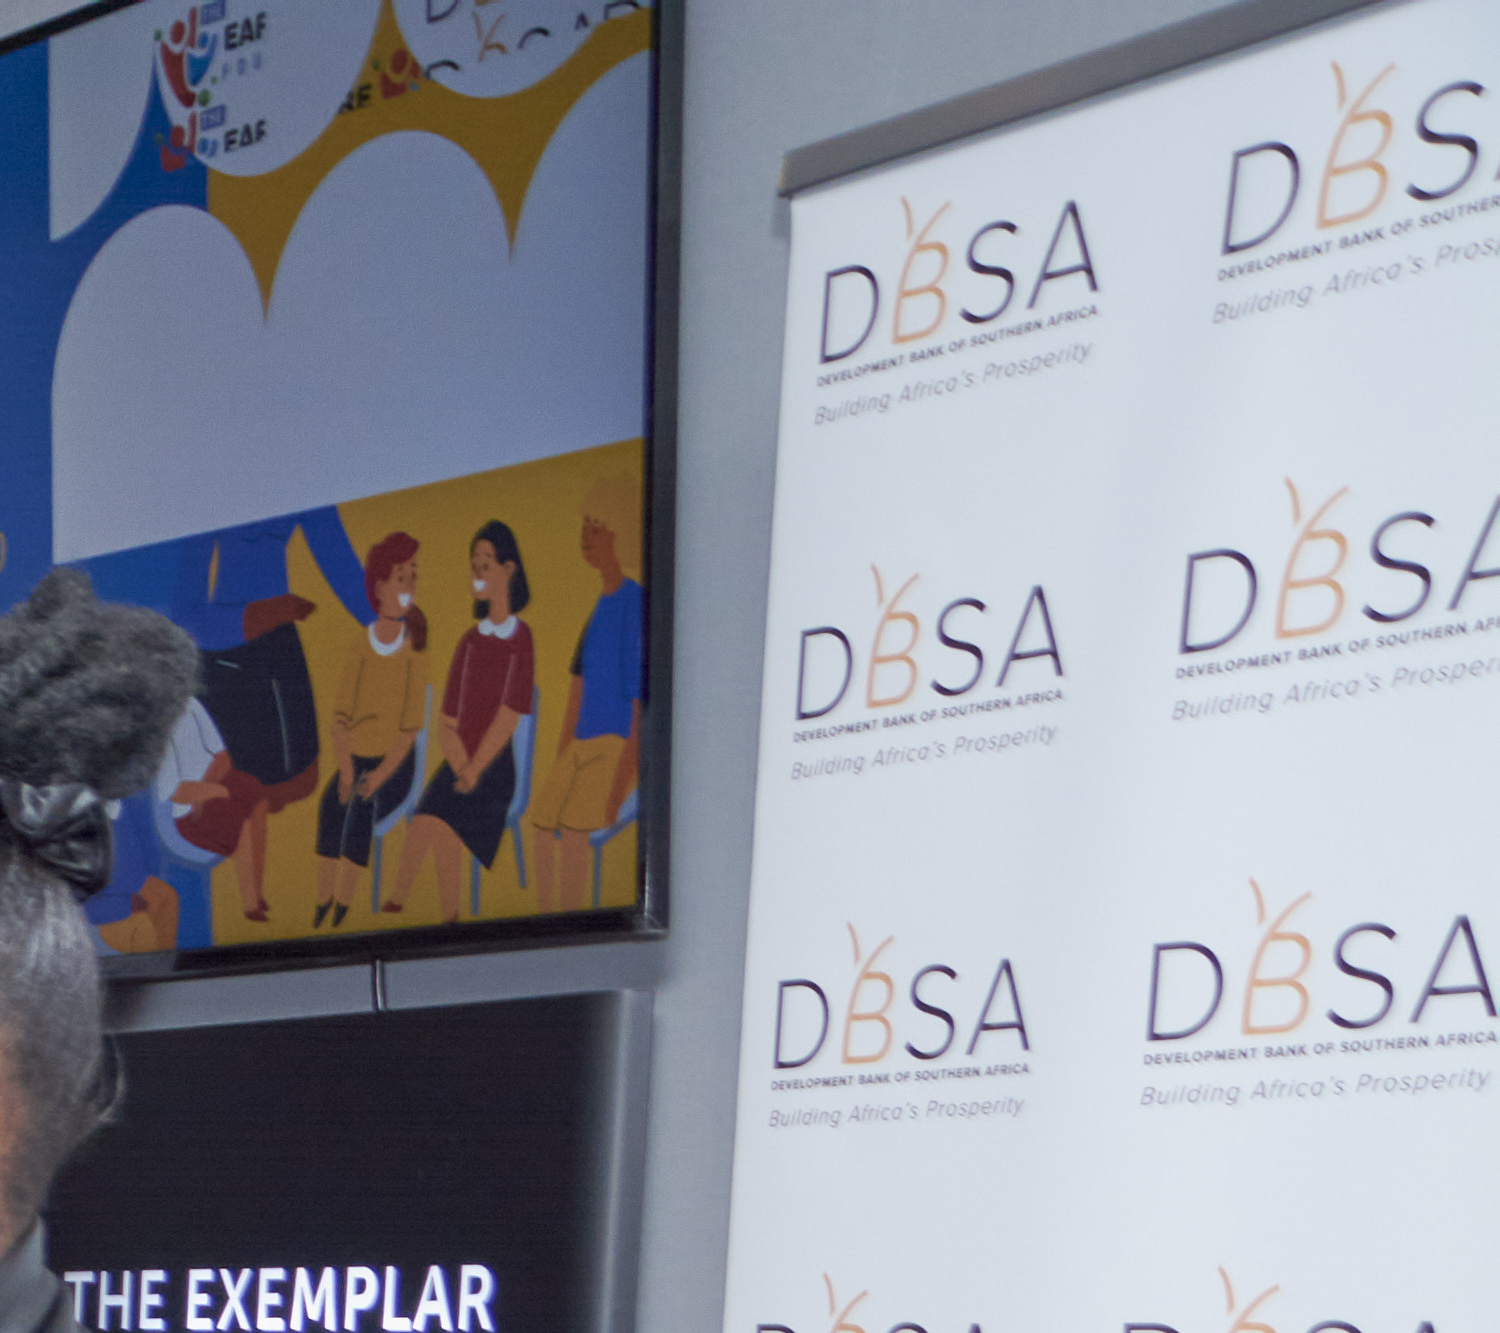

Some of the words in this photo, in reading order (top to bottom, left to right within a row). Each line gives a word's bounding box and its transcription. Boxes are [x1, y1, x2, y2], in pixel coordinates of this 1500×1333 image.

[1220, 60, 1500, 257] DBS
[818, 196, 1099, 365] DBSA
[795, 563, 1064, 721] DBSA
[772, 919, 1032, 1070] DBSA
[1145, 876, 1499, 1042] DBSA
[1139, 1083, 1243, 1107] Building
[1249, 1075, 1348, 1101] Africa's
[1355, 1068, 1492, 1096] Prosperity
[1143, 1047, 1259, 1066] DEVELOPMENT
[1263, 1044, 1309, 1059] BANK
[1312, 1042, 1335, 1056] OF
[1339, 1035, 1430, 1054] SOUTHERN
[1434, 1030, 1499, 1047] AFRICA
[64, 1269, 168, 1332] THE
